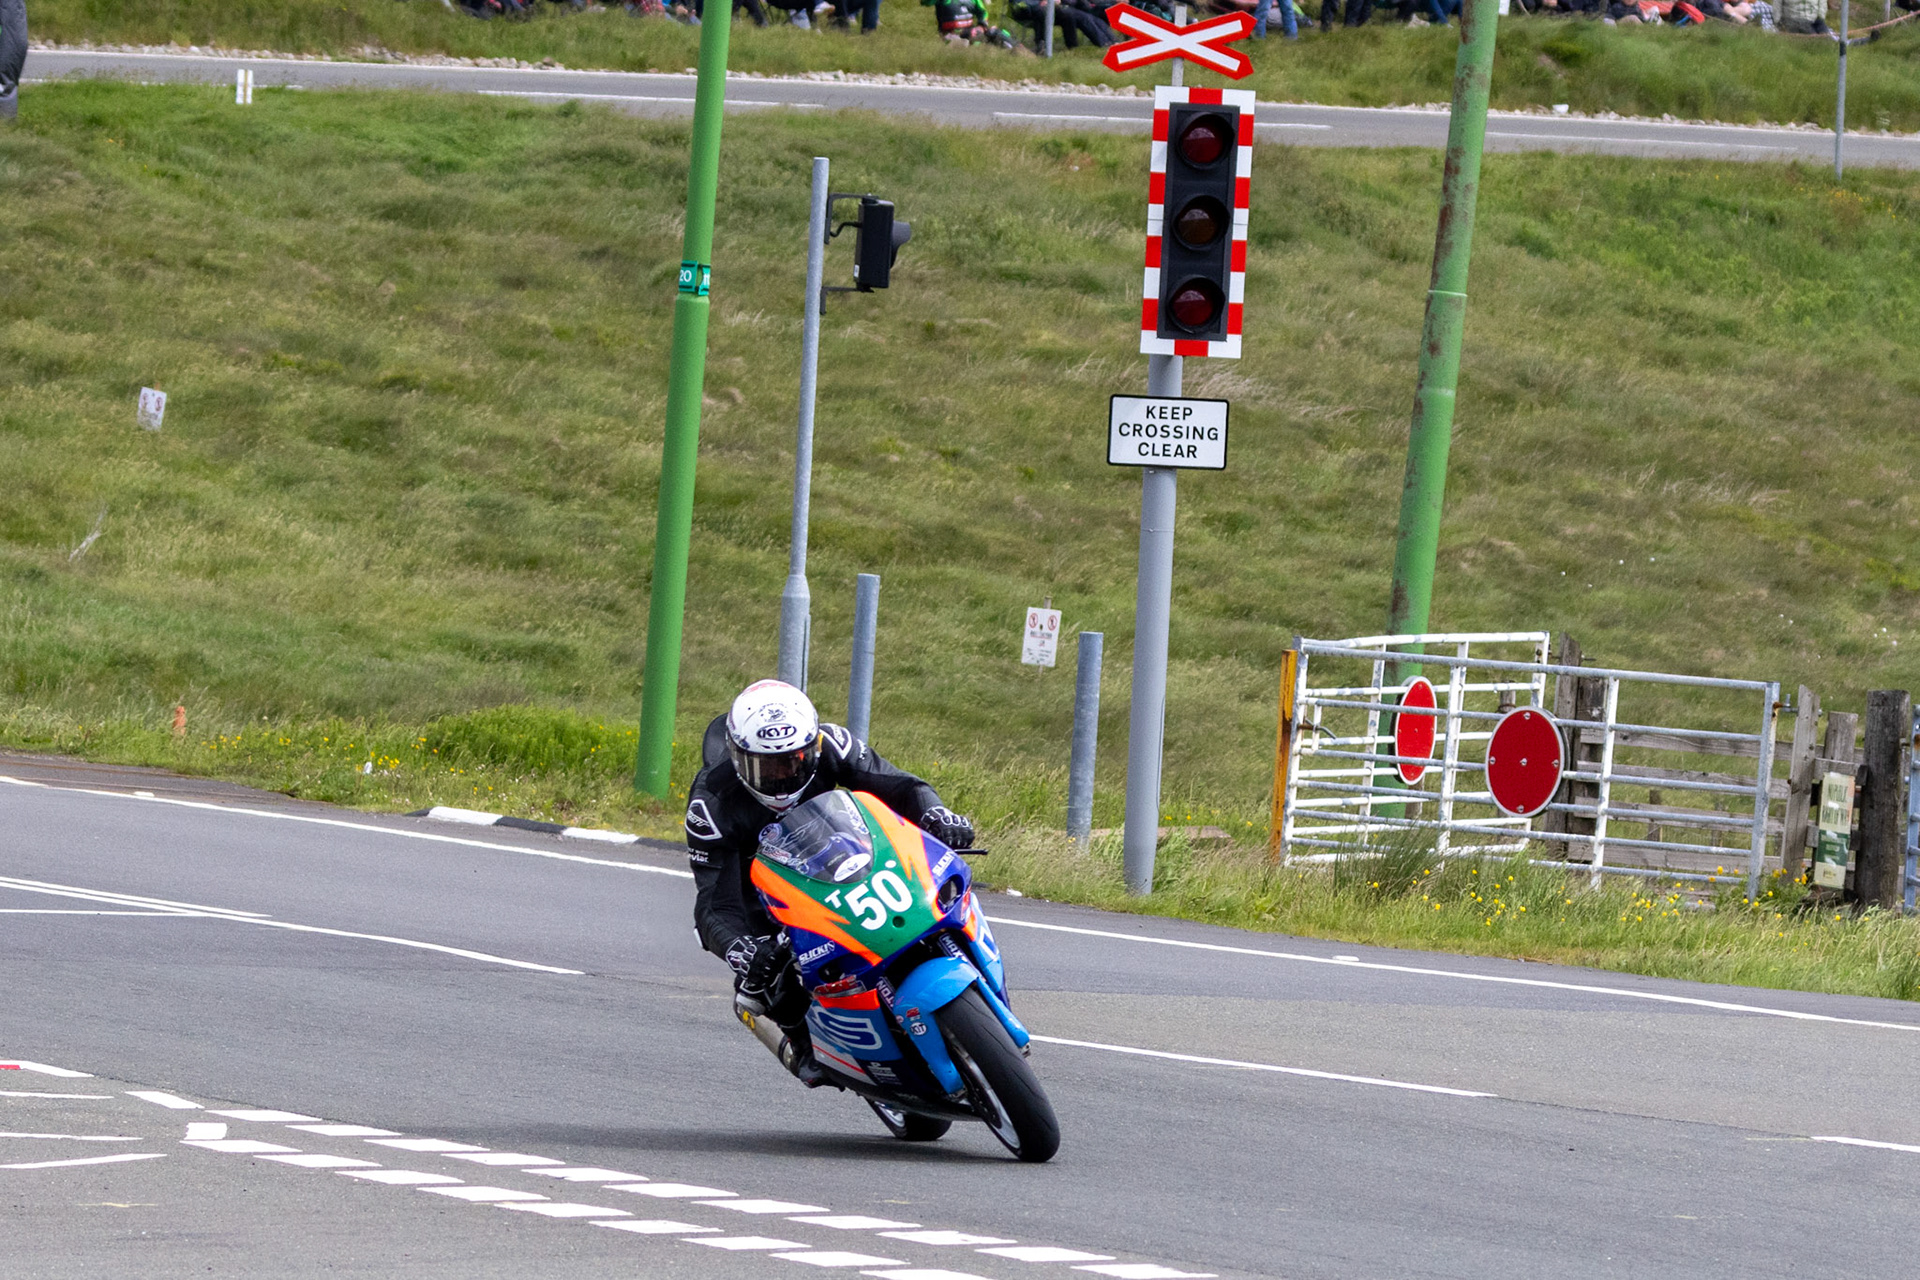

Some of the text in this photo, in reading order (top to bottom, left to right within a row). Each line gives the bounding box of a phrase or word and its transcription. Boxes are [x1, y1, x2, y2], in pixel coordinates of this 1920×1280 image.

[1146, 405, 1193, 420] KEEP
[1118, 422, 1219, 441] CROSSING
[1138, 442, 1198, 458] CLEAR
[824, 870, 913, 931] T 50
[876, 980, 895, 1007] TON
